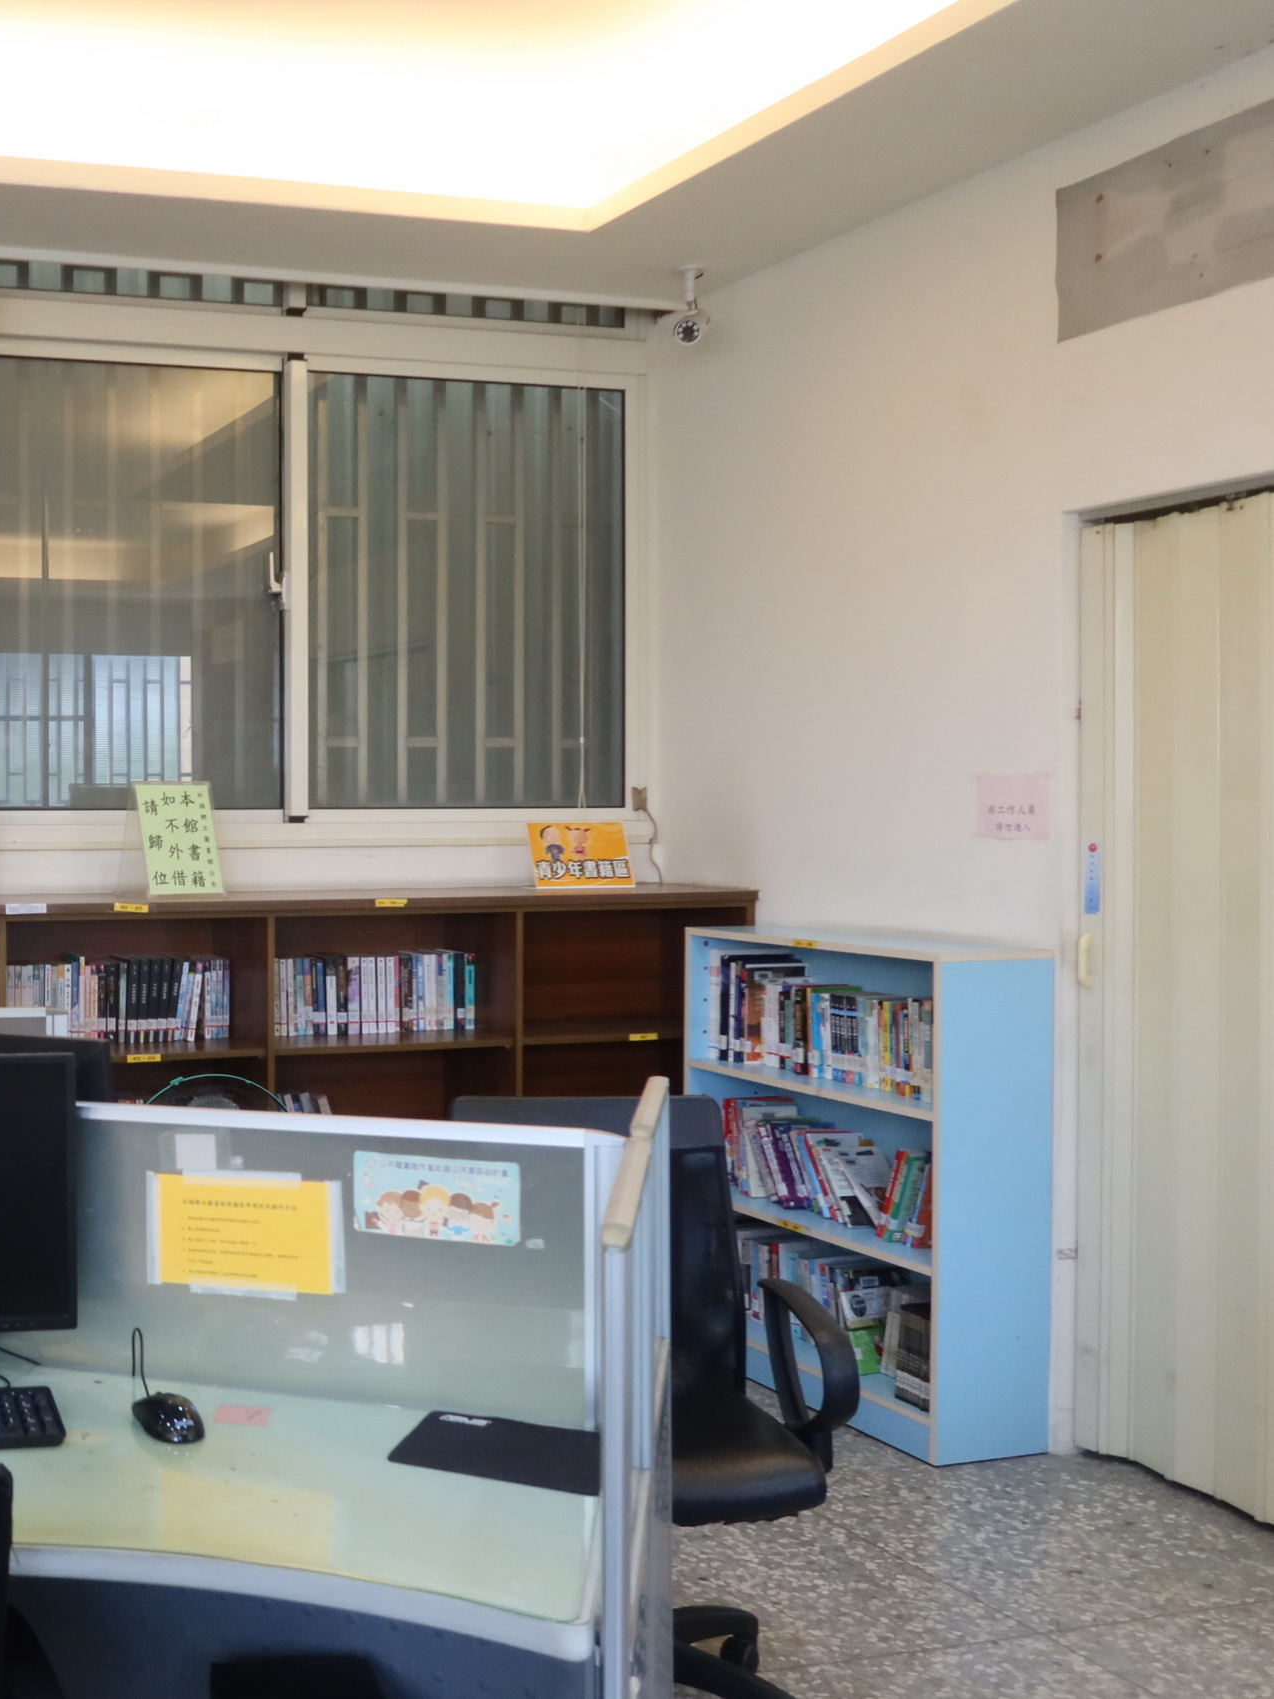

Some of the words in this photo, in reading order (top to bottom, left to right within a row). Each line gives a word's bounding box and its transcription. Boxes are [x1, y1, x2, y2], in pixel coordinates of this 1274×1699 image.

[142, 798, 169, 886] 請歸位
[160, 791, 188, 887] 如不外借
[179, 790, 206, 888] 本館書籍
[536, 858, 631, 880] 青少年書籍區
